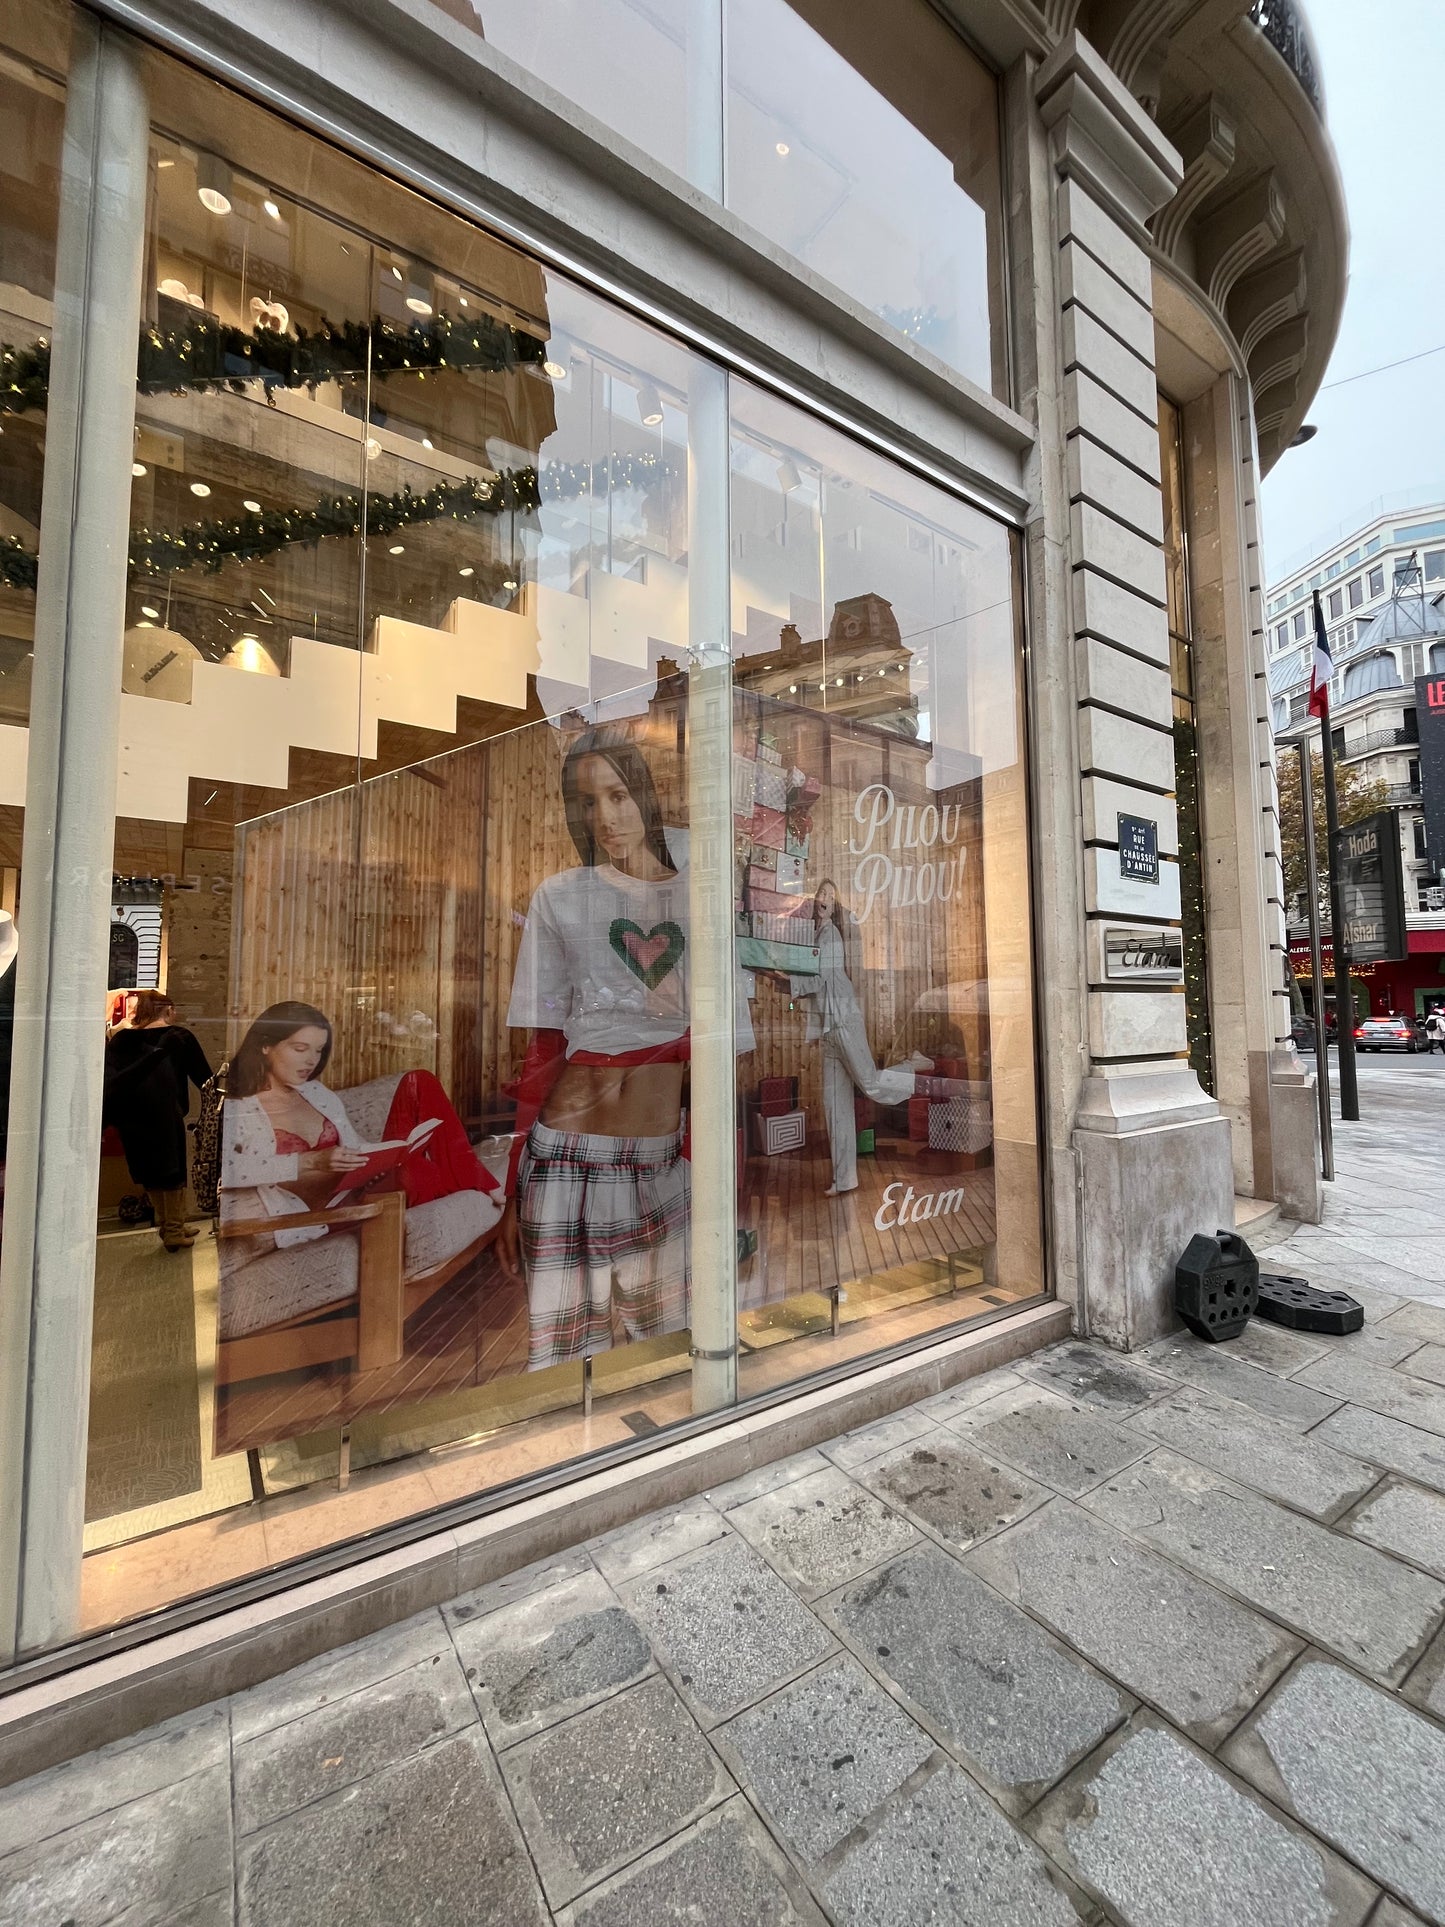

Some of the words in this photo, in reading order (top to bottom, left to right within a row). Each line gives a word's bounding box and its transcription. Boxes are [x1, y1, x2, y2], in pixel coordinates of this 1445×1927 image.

[849, 783, 961, 855] PILOU
[1133, 834, 1145, 845] RUE
[1348, 828, 1377, 859] Hoda
[1126, 859, 1153, 873] D'ANTIN
[874, 1182, 965, 1232] Etam
